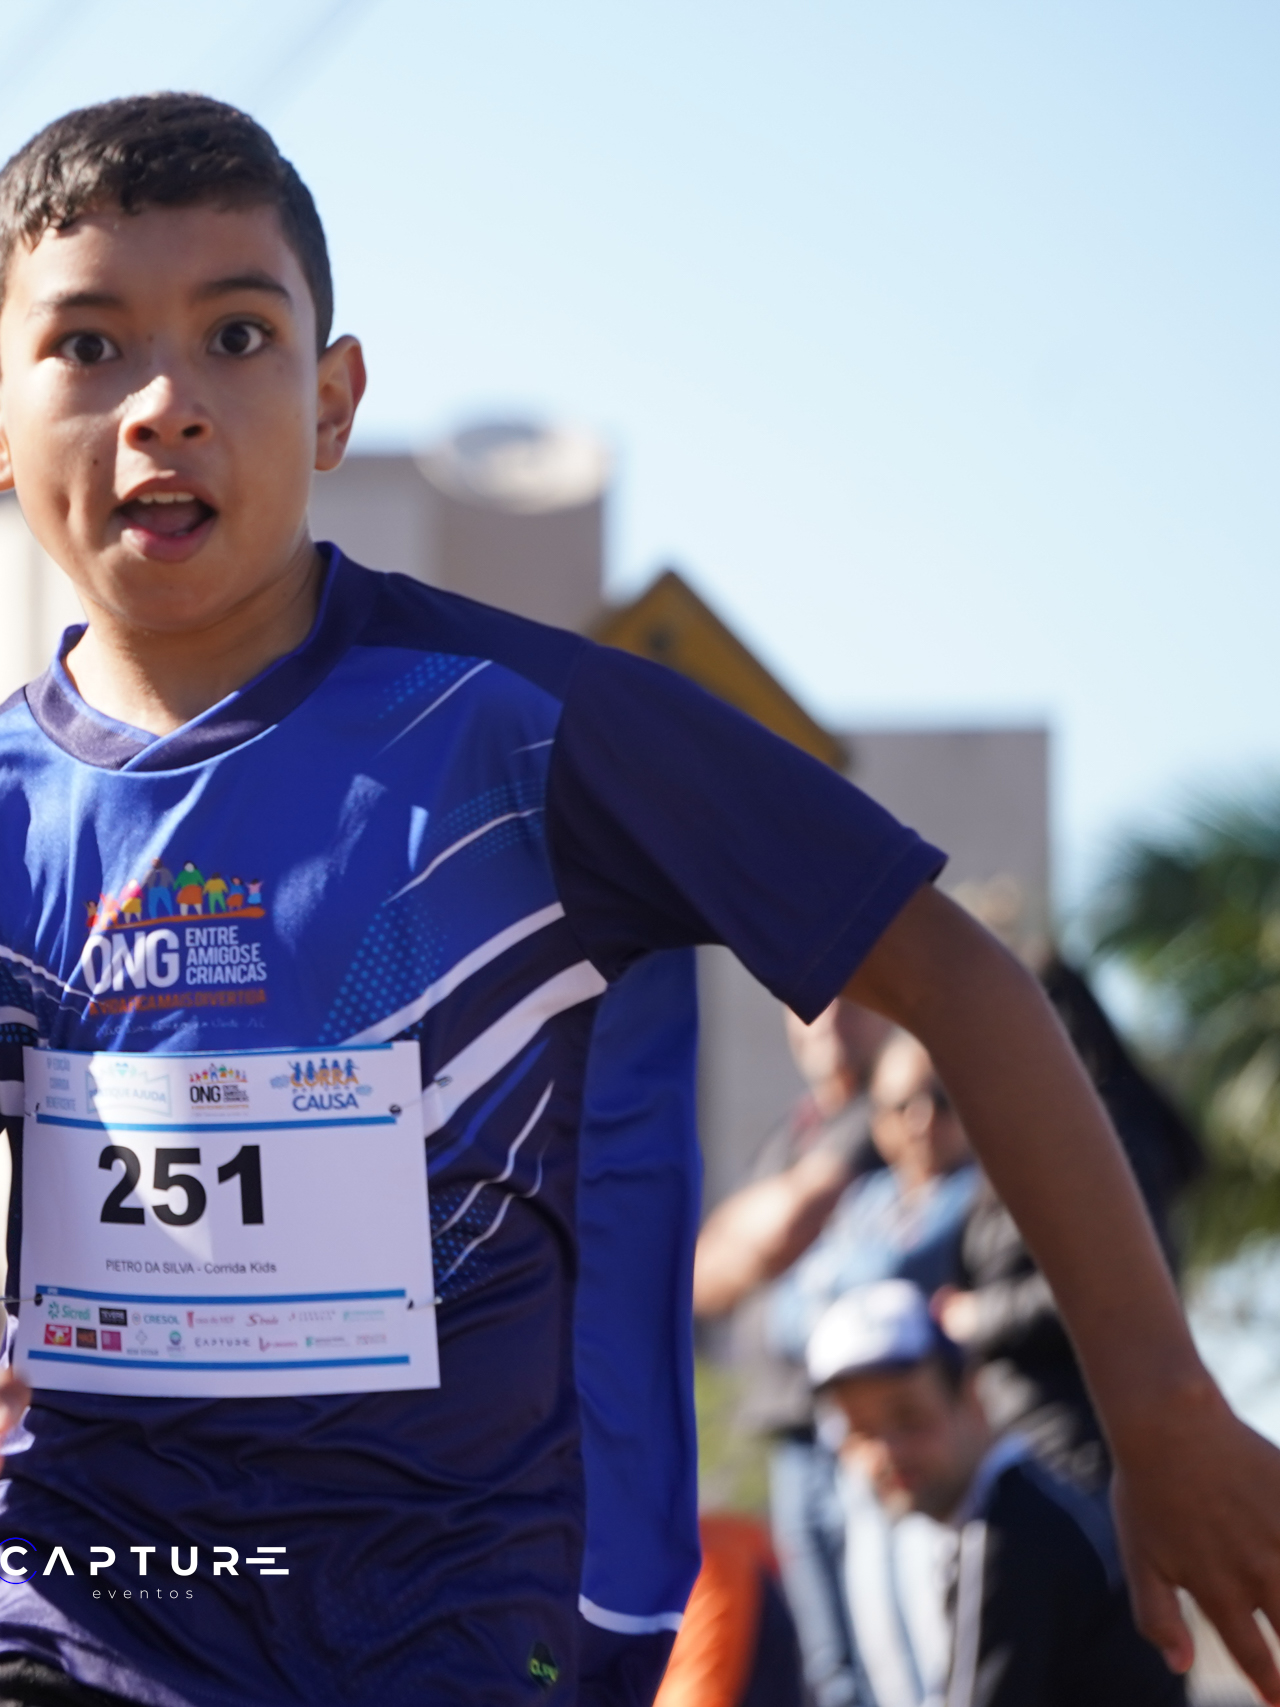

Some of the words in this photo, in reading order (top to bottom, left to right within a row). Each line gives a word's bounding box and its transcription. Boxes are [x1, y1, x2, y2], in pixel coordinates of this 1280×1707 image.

[185, 925, 239, 947] ENTRE
[81, 929, 180, 994] ONG
[190, 1085, 220, 1103] ONG
[293, 1093, 360, 1112] CAUSA
[98, 1144, 265, 1226] 251
[106, 1259, 142, 1273] PIETRO
[144, 1261, 161, 1273] DA
[163, 1262, 194, 1274] SILVA
[204, 1262, 246, 1274] Corrida
[250, 1261, 277, 1273] Kids
[143, 1314, 180, 1325] CRESOL
